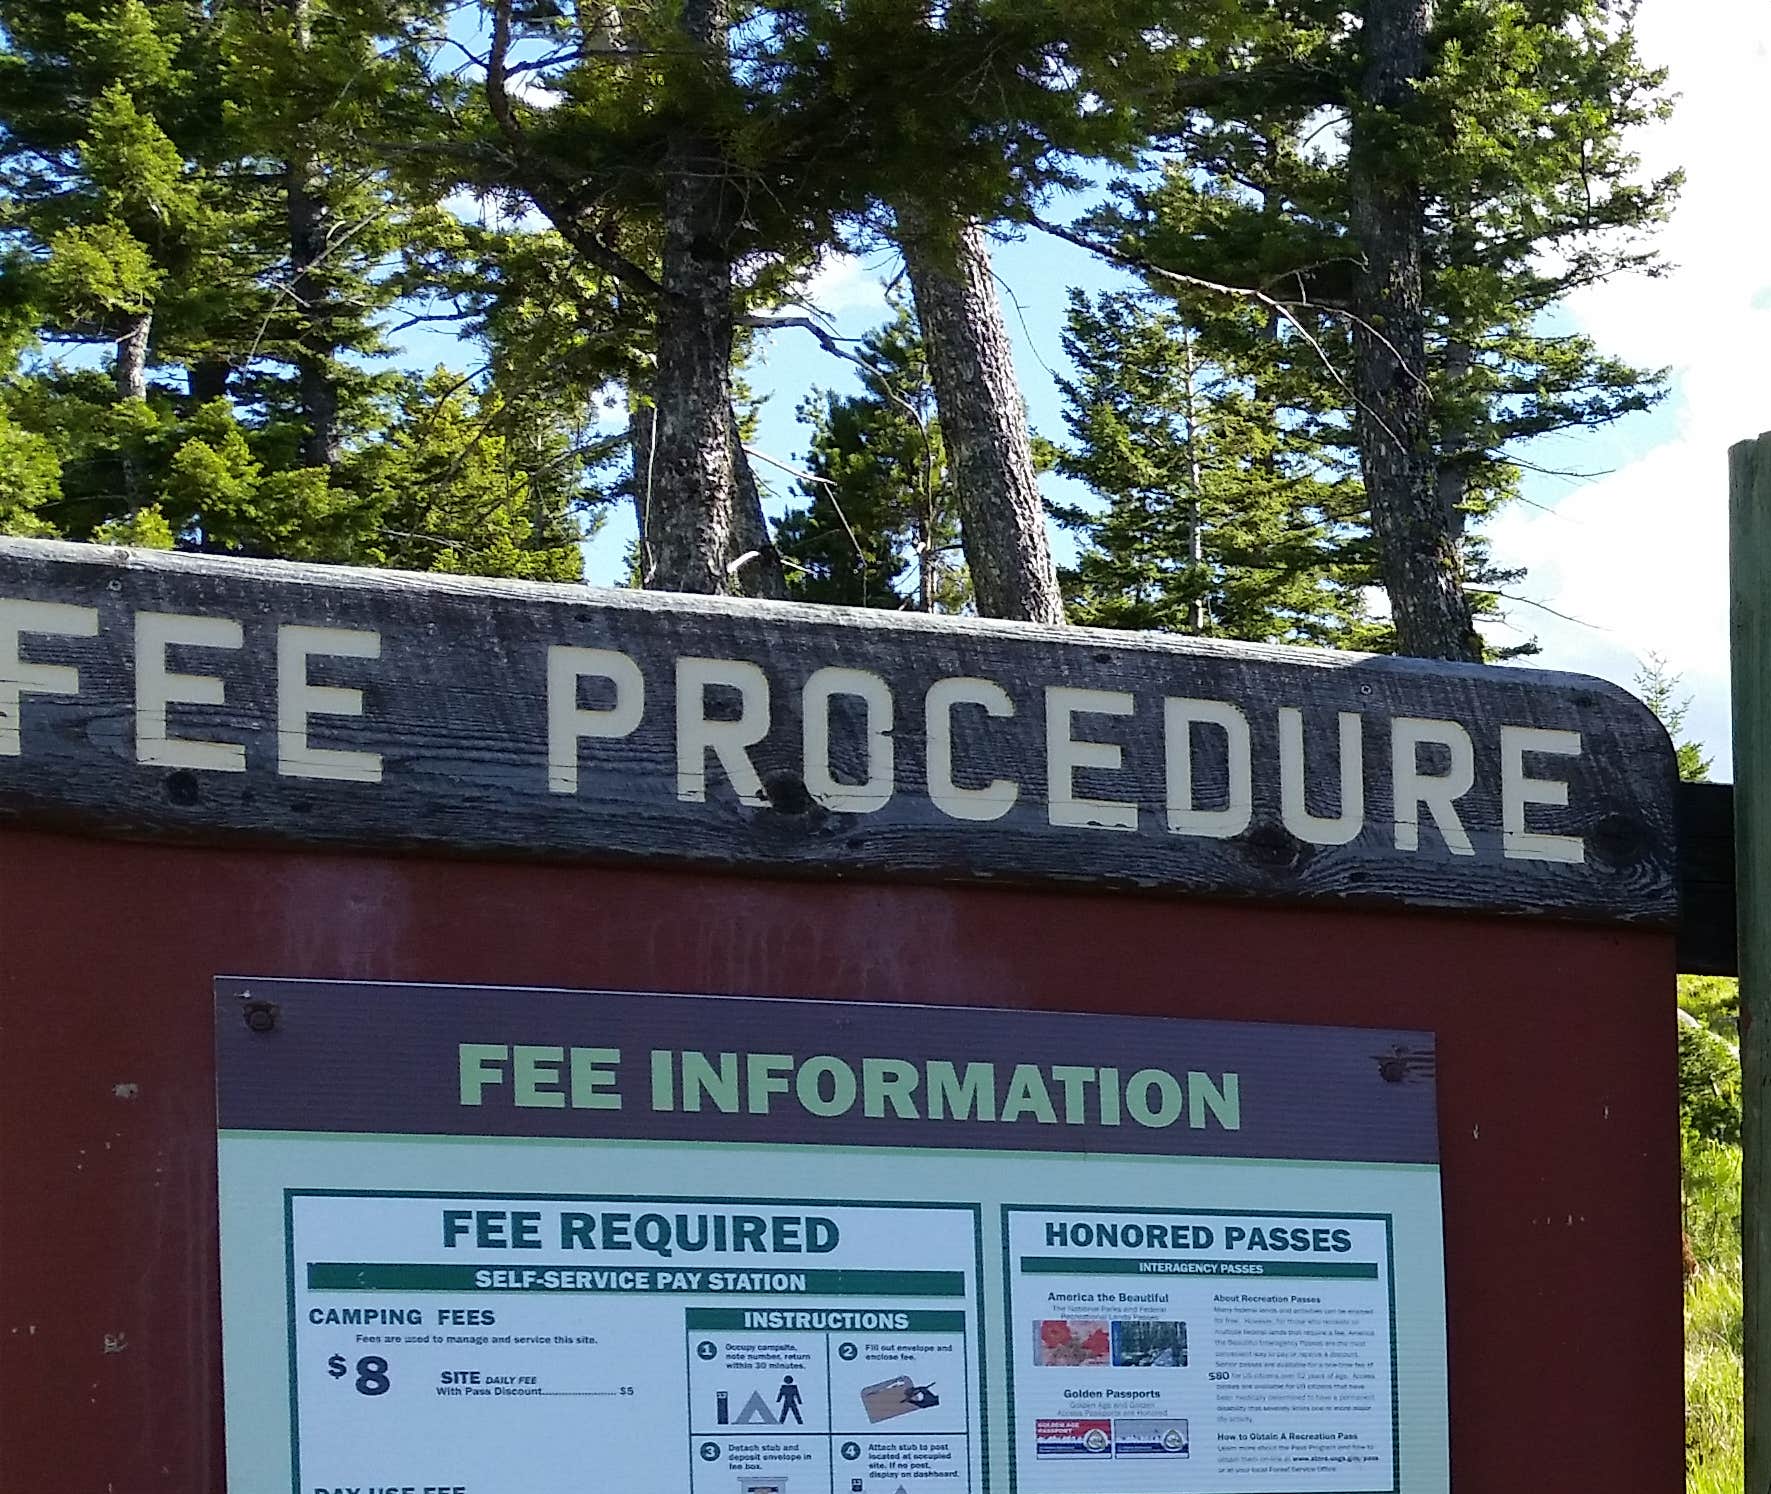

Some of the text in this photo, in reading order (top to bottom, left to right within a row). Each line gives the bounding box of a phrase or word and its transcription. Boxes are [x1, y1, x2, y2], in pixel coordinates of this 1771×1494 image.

[0, 598, 1585, 863] FEE PROCEDURE
[459, 1044, 1240, 1129] FEE INFORMATION
[443, 1210, 839, 1257] FEE REQUIRED
[1046, 1223, 1351, 1252] HONORED PASSES
[476, 1270, 805, 1290] SELF-SERVICE PAY STATION
[309, 1309, 495, 1325] CAMPING FEES
[745, 1312, 909, 1329] INSTRUCTIONS
